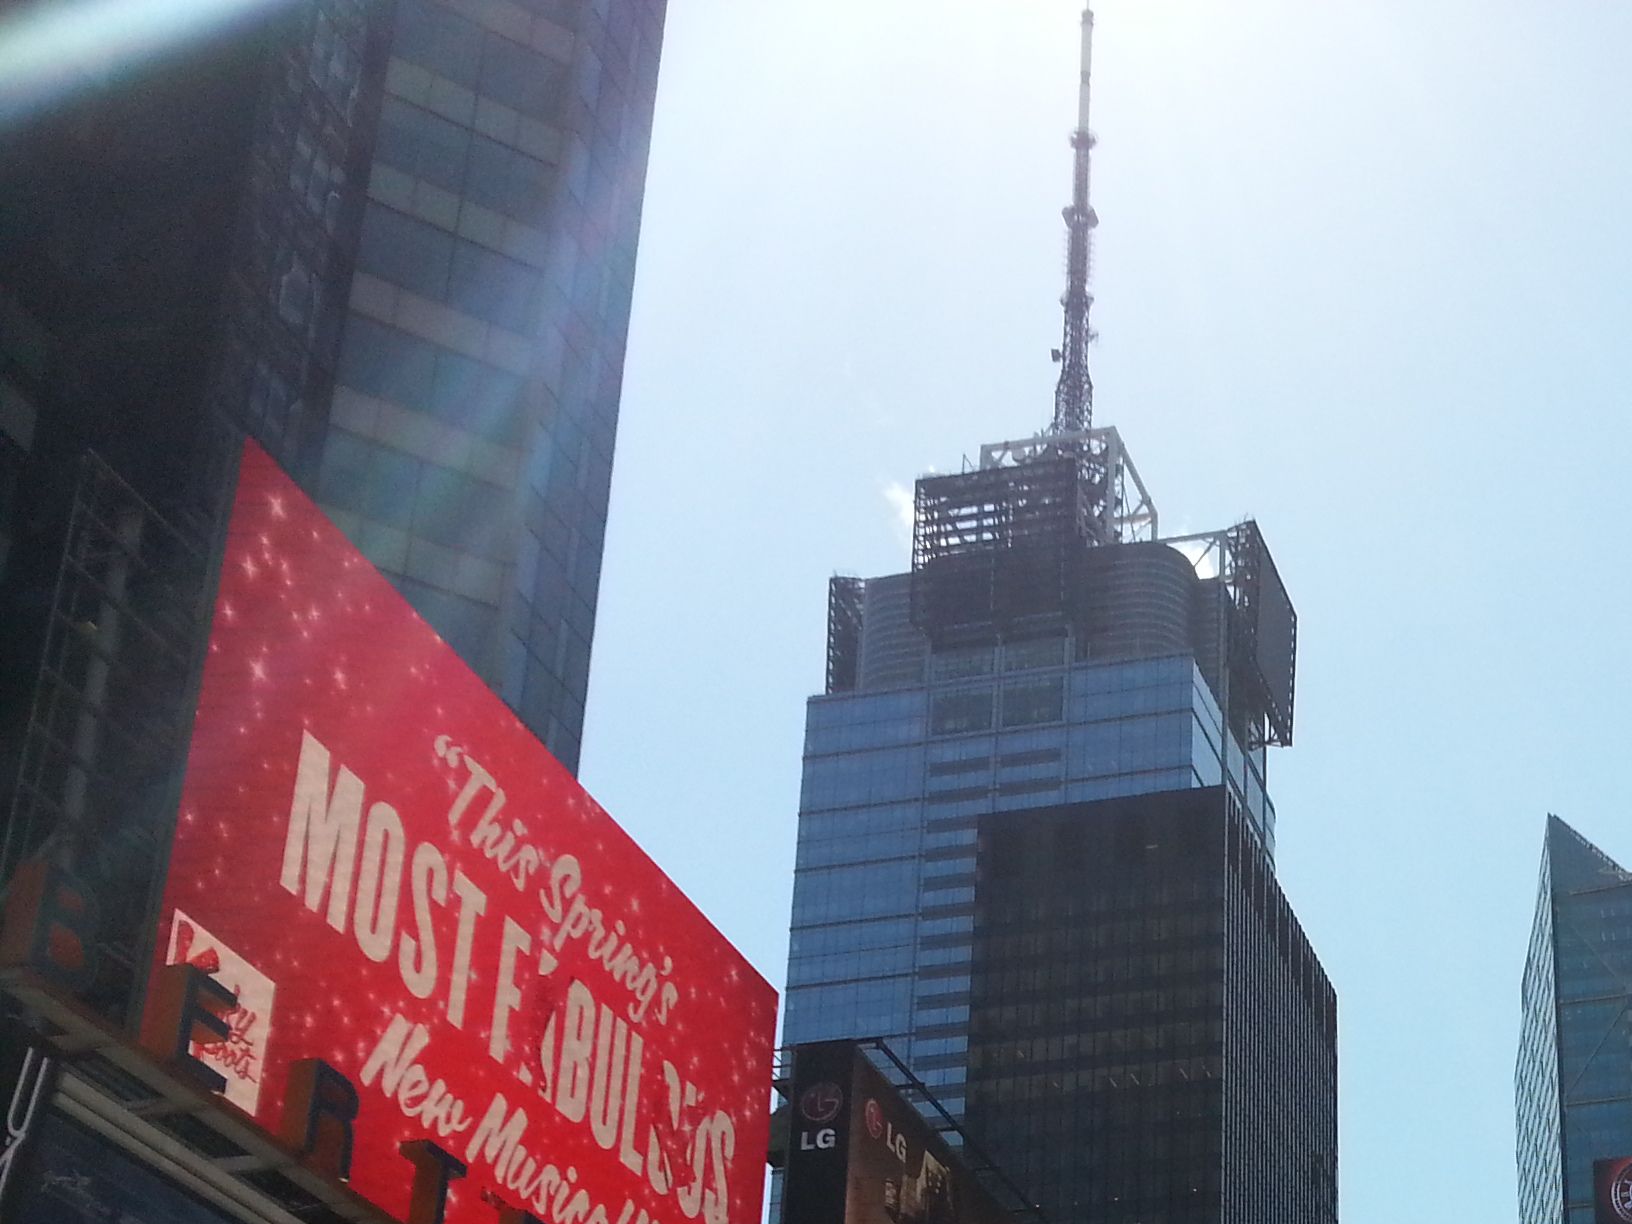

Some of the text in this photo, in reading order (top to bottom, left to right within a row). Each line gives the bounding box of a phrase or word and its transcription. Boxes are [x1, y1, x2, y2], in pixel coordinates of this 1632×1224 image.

[280, 728, 487, 1030] MOST
[360, 1013, 471, 1138] New
[801, 1128, 836, 1151] LG
[885, 1121, 908, 1164] LG
